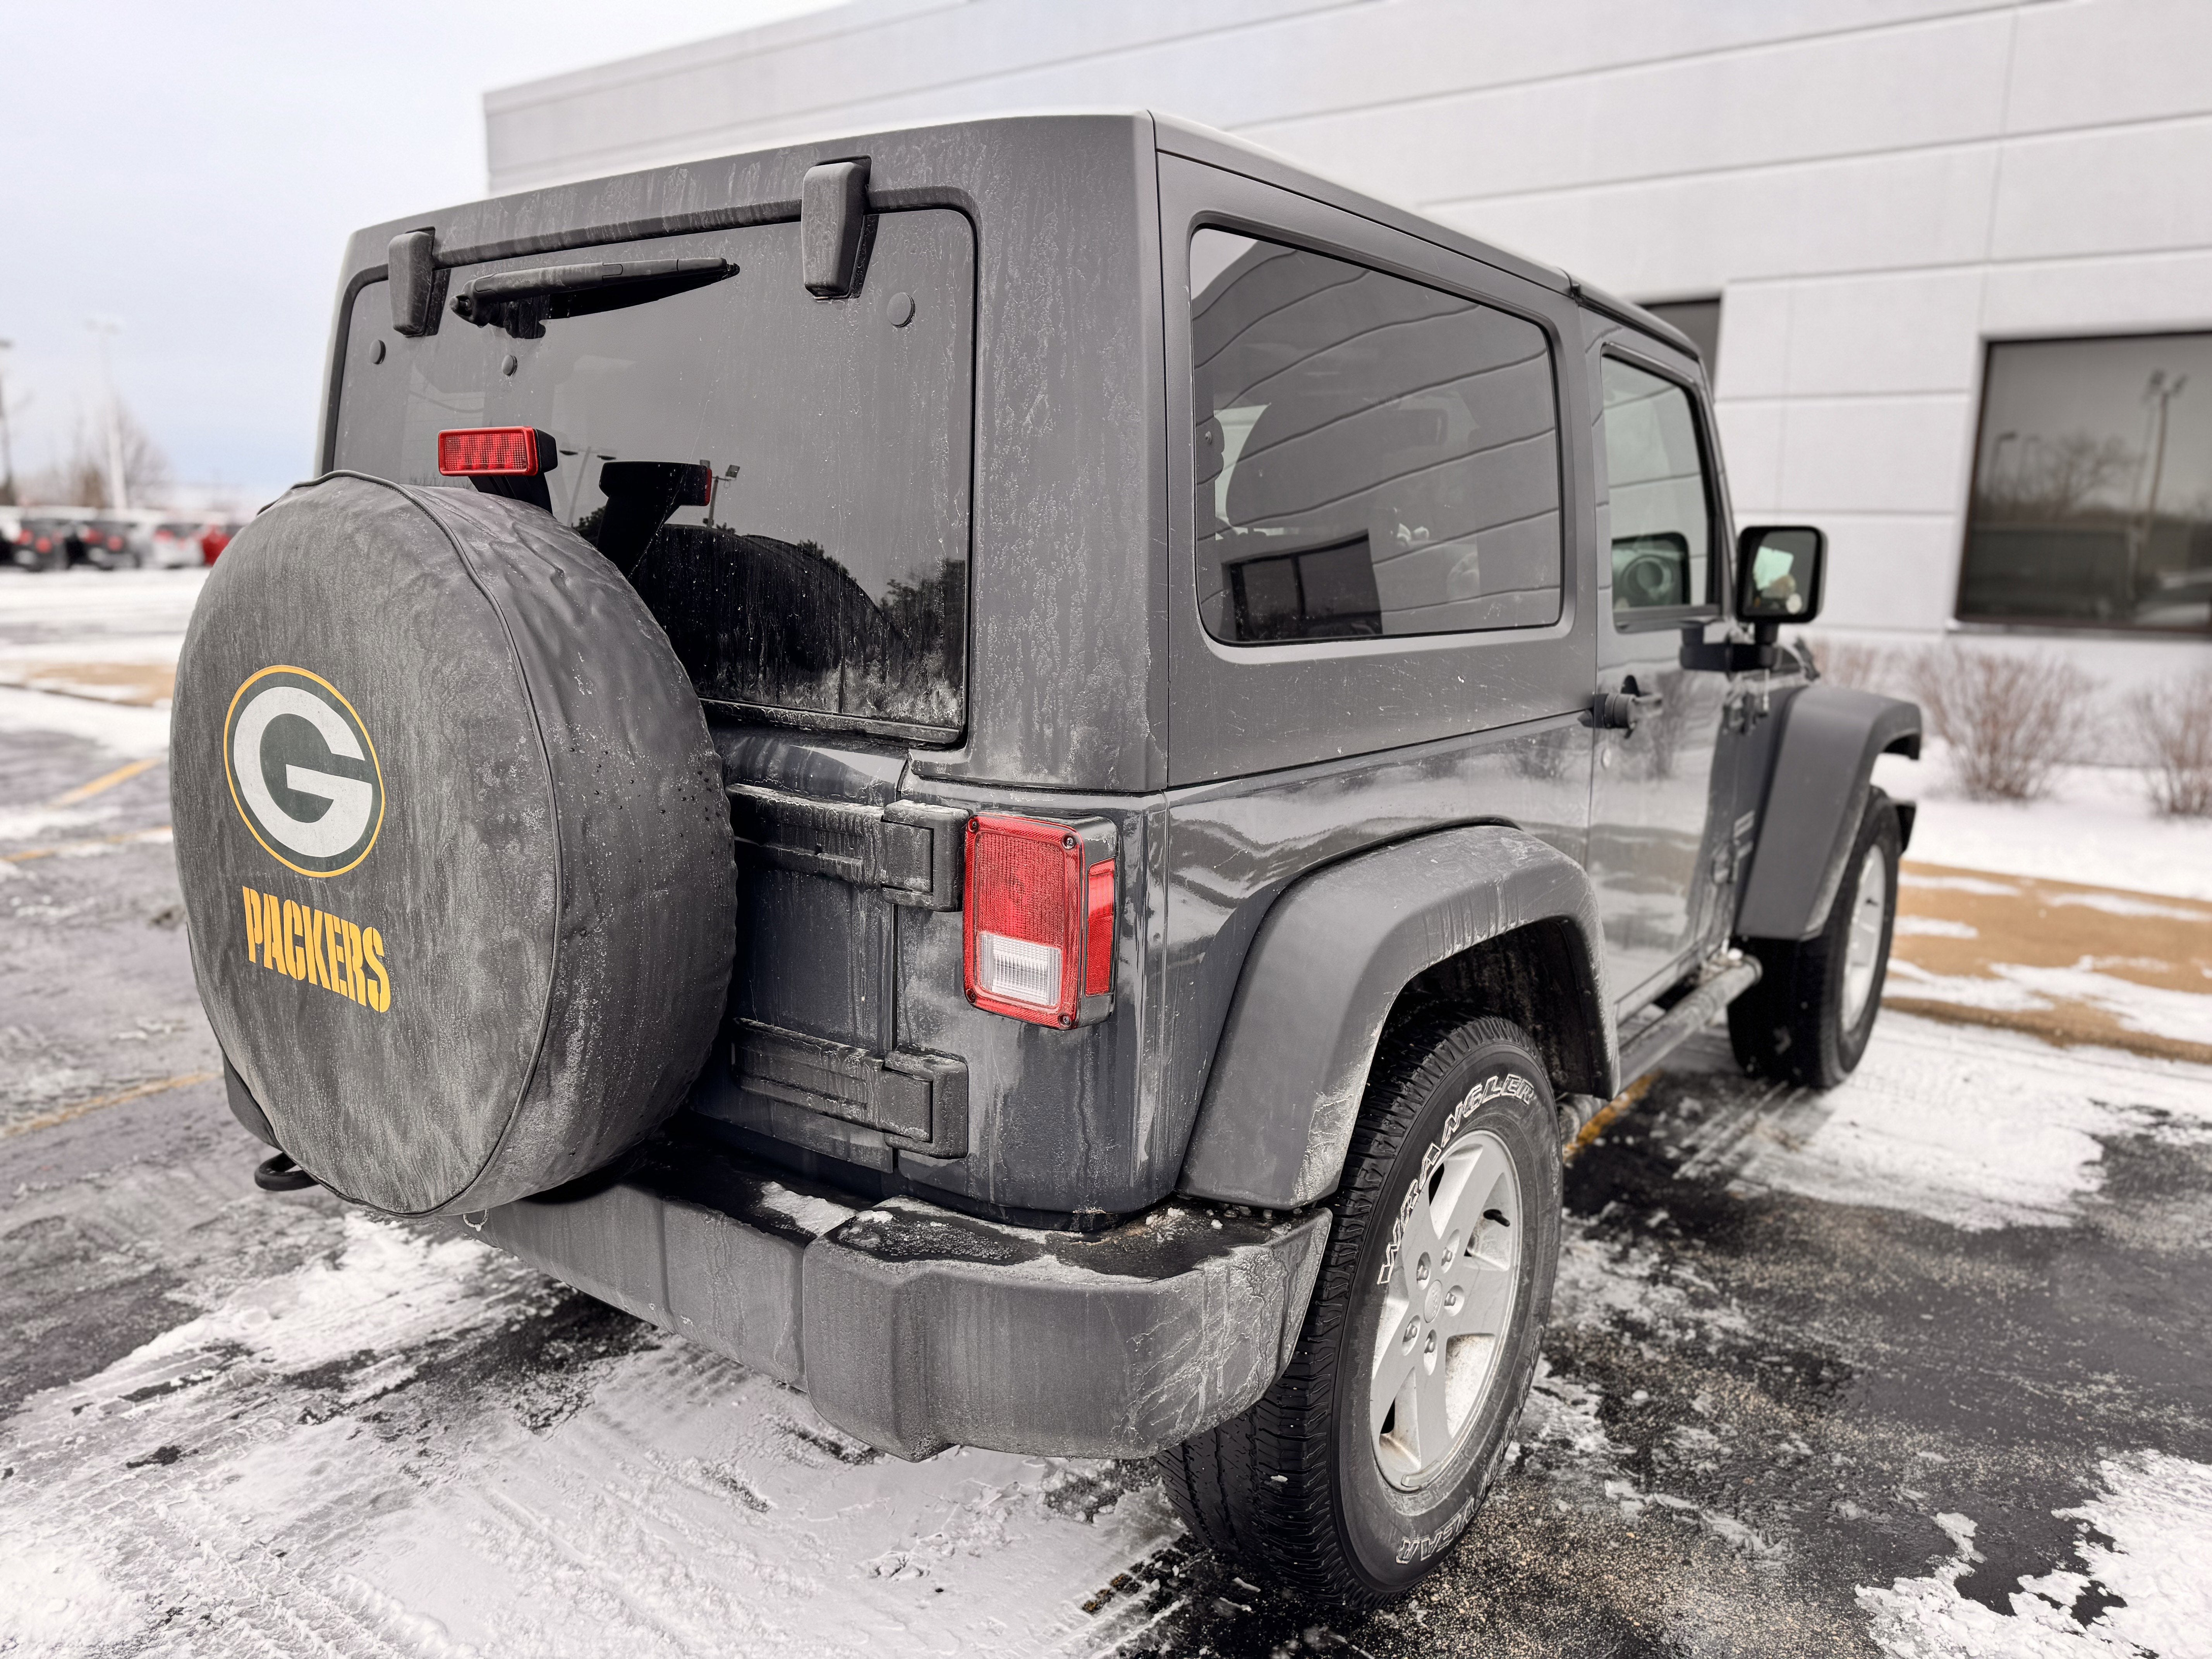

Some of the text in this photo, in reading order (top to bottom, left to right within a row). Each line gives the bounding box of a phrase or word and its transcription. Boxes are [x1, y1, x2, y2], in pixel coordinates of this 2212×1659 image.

[234, 686, 372, 858] G
[242, 886, 391, 1013] PACKERS
[1377, 1073, 1534, 1285] WRANGLER
